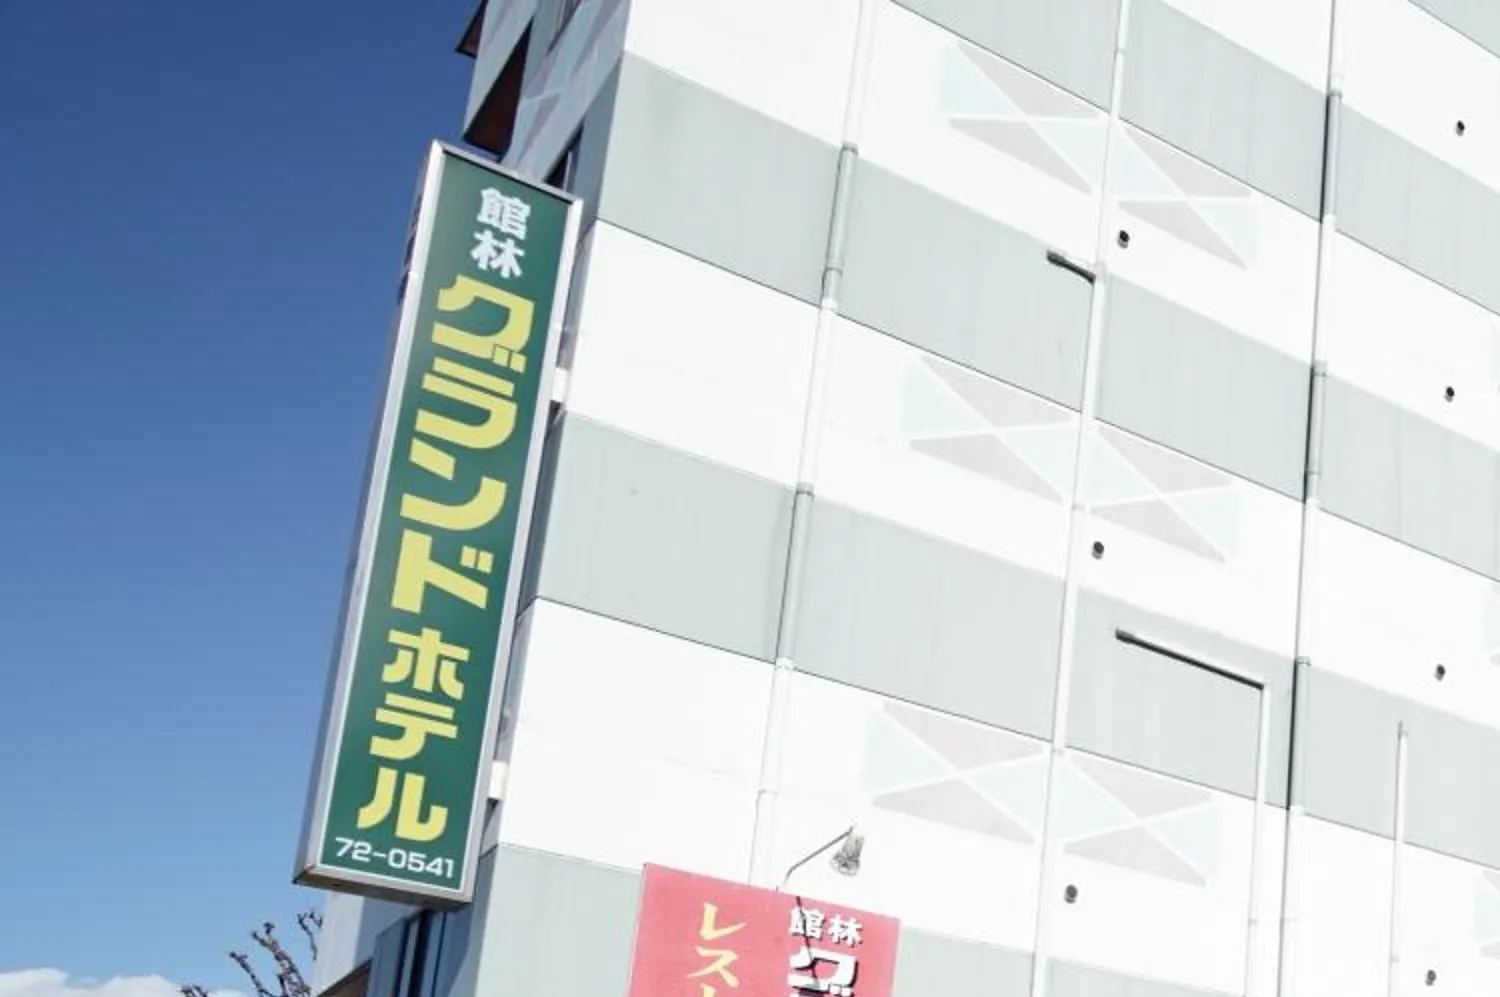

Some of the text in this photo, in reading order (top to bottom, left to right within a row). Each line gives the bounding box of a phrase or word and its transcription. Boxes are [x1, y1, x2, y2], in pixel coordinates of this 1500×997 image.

[356, 186, 534, 842] 館林 グランドホテル
[335, 836, 454, 879] 72-0541
[789, 906, 863, 948] 館林
